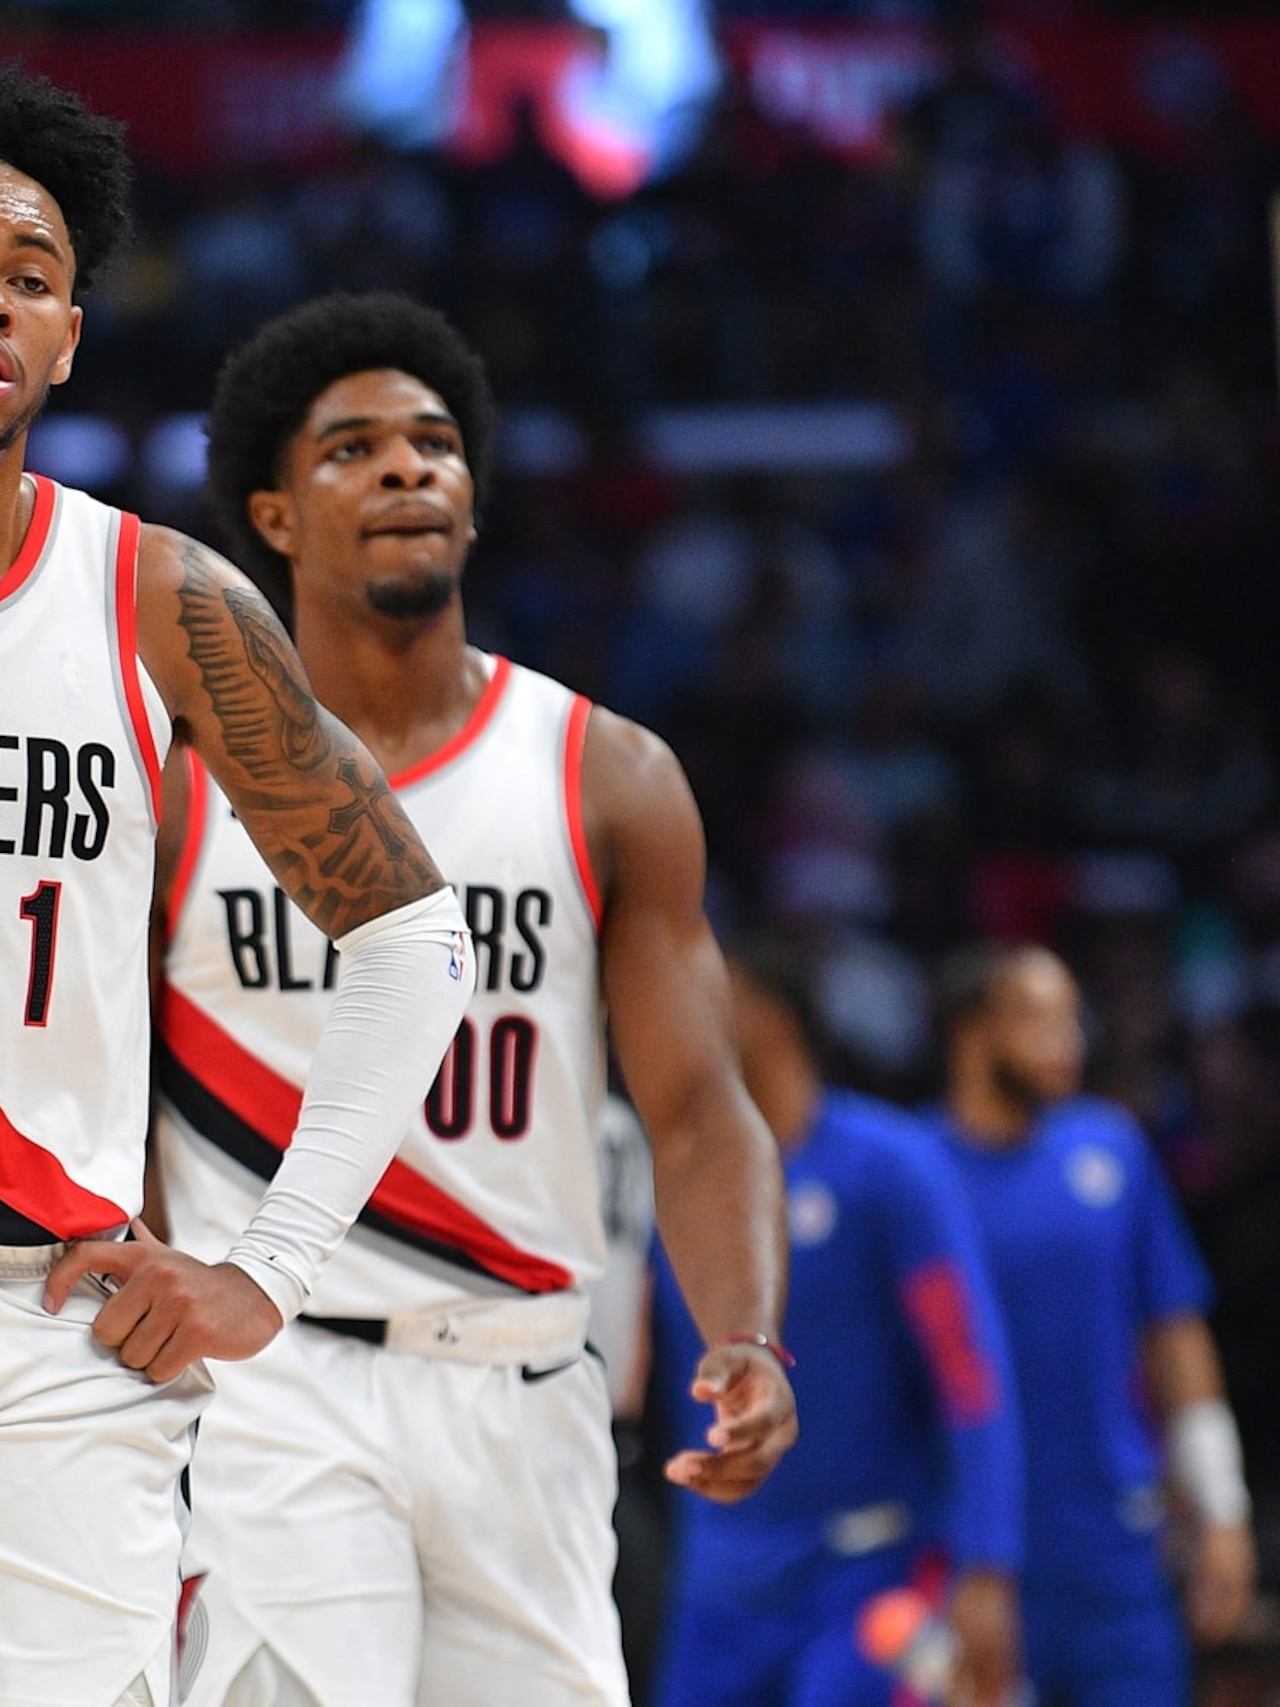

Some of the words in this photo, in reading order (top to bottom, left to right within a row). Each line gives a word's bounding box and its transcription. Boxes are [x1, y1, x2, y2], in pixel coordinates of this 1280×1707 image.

[19, 880, 62, 1027] 1
[215, 885, 553, 993] BLRS
[424, 1015, 538, 1142] 00
